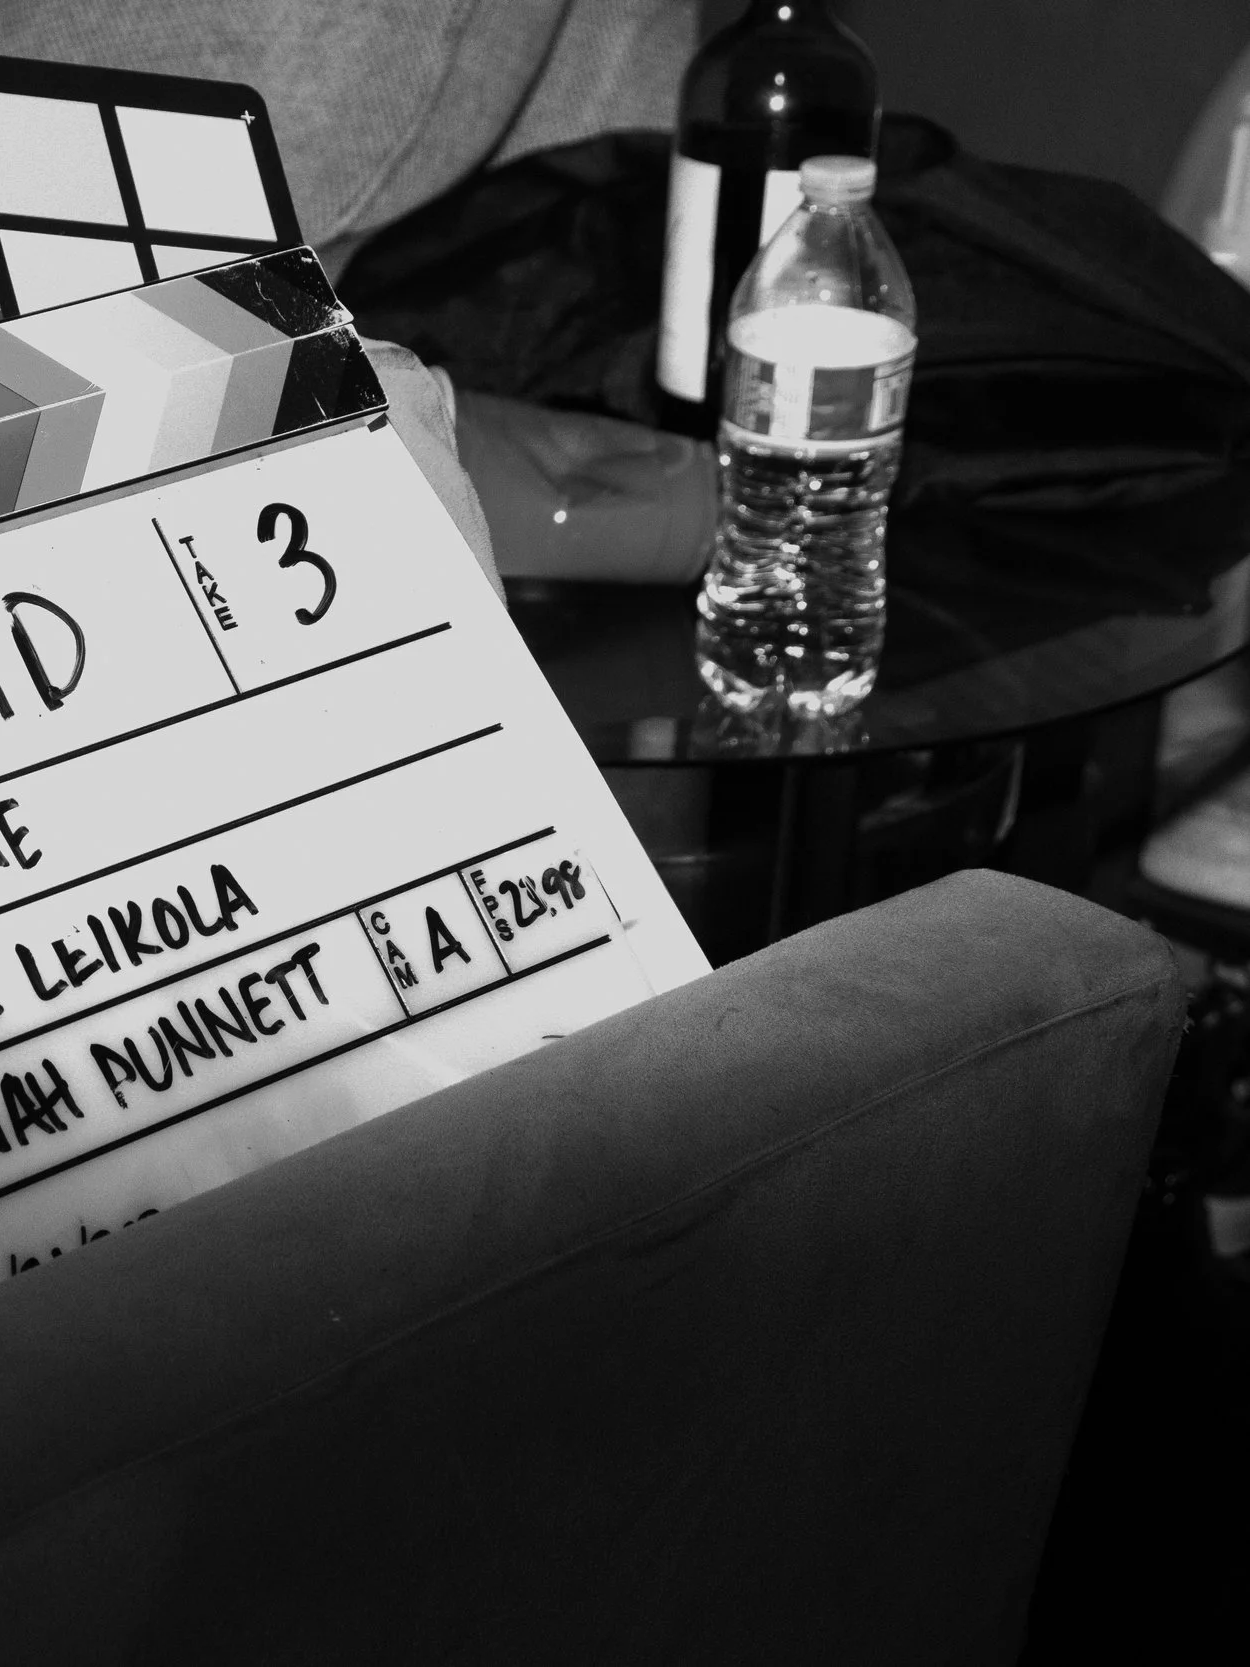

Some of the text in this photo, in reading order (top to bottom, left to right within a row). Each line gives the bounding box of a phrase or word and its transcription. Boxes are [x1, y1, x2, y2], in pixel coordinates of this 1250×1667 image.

[179, 535, 238, 631] TAKE
[257, 502, 337, 626] 3
[14, 864, 259, 1001] LEIKOLA
[425, 906, 472, 974] A
[470, 869, 515, 942] FPS
[370, 911, 419, 990] CAM
